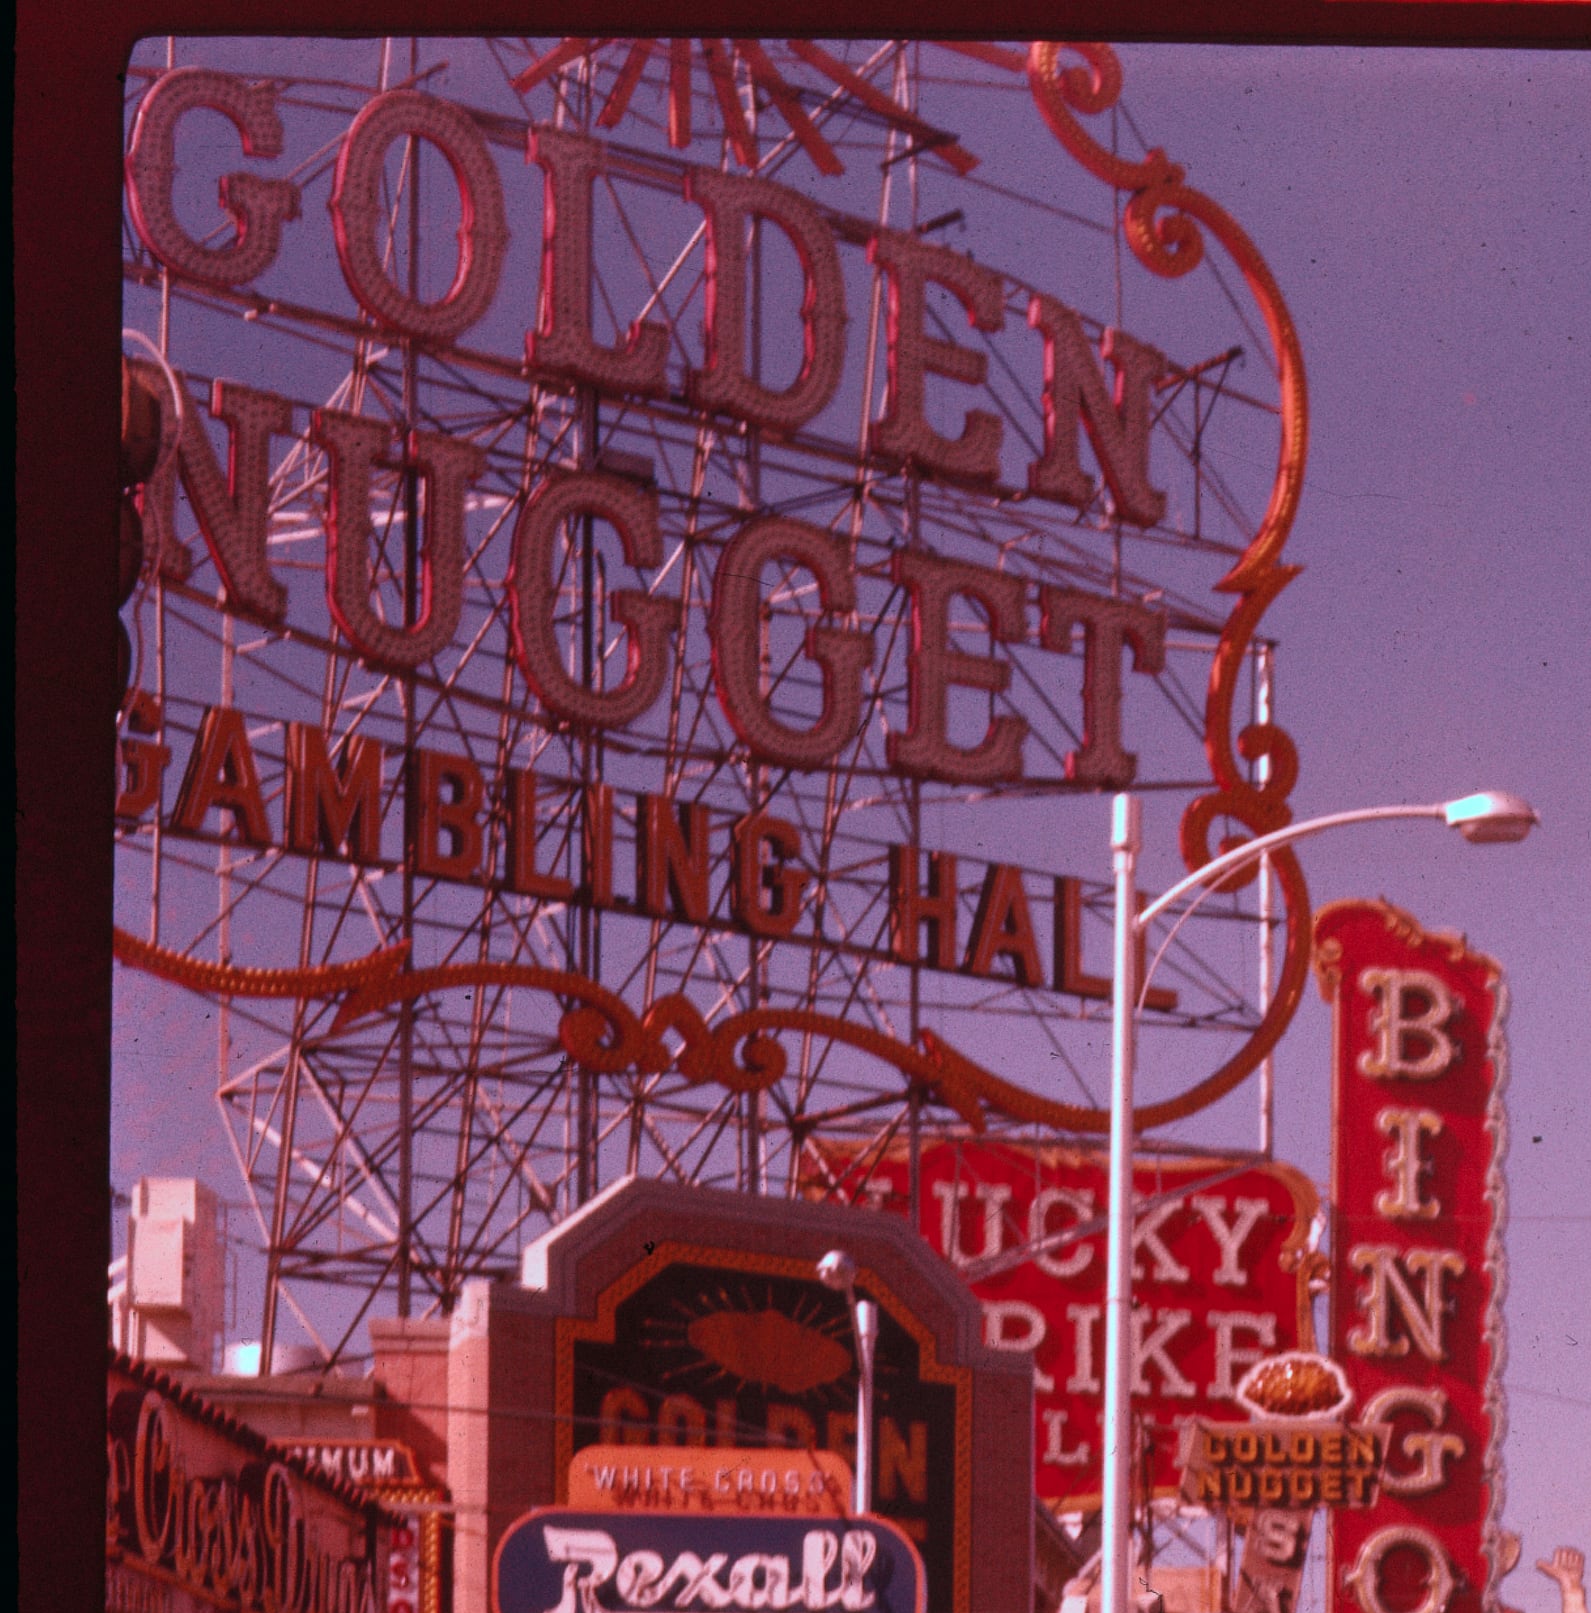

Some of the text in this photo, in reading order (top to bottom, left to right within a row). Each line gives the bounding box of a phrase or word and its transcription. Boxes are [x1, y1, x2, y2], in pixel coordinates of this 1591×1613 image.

[123, 65, 1167, 527] GOLDEN
[127, 377, 1167, 788] NUGGET
[115, 688, 1178, 1011] GAMBLING HALL
[862, 1180, 1269, 1286] UCKY
[1199, 1470, 1374, 1501] NUGGET
[1203, 1431, 1376, 1465] GOLDEN
